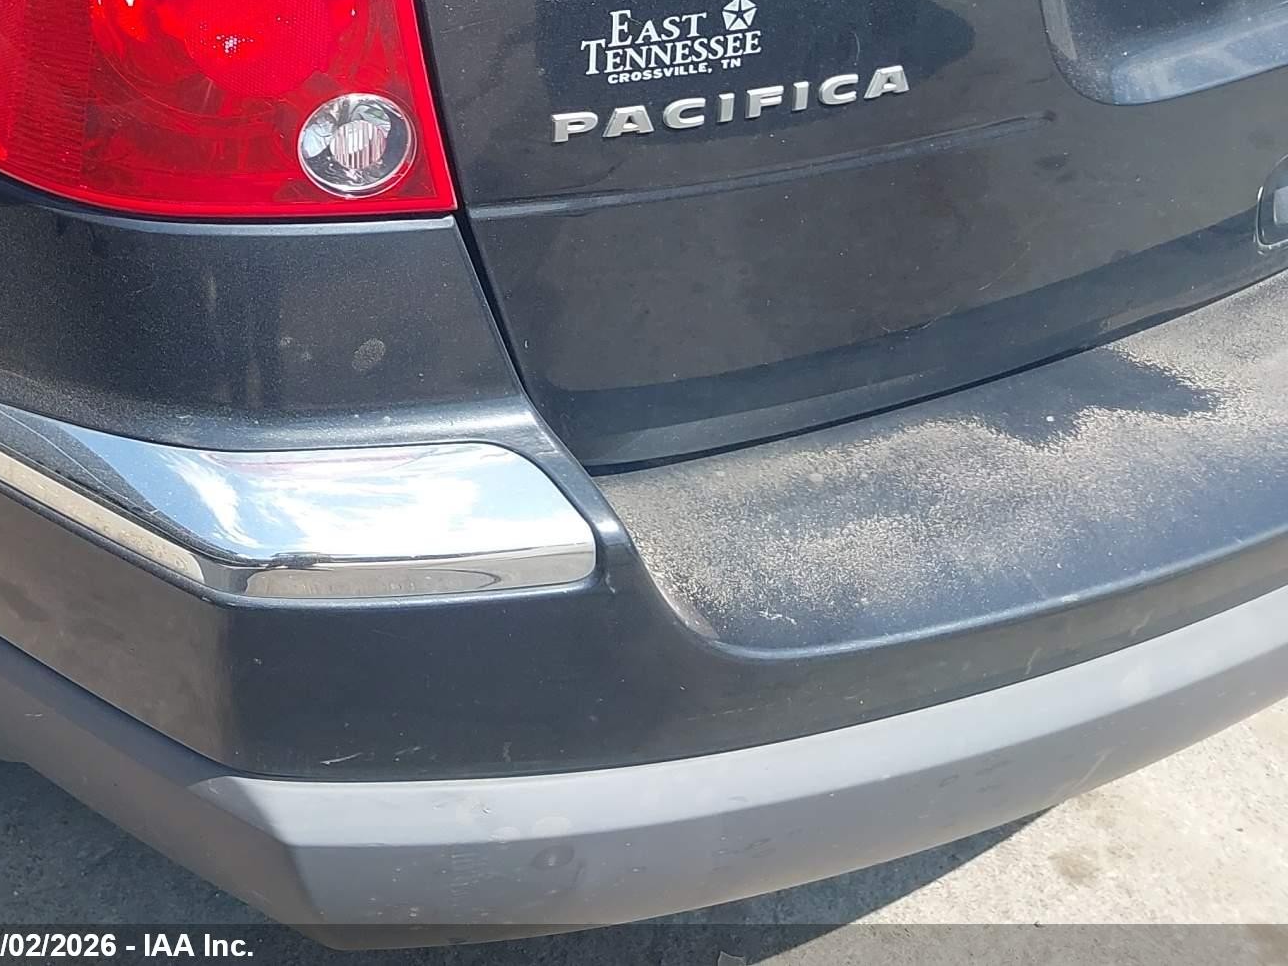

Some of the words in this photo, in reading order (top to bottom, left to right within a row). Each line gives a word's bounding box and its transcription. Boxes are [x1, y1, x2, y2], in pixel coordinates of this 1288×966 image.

[608, 9, 707, 47] EAST
[580, 30, 762, 75] TENNESSEE
[607, 63, 713, 84] CROSSVILLE,
[720, 57, 742, 69] TN
[551, 64, 910, 143] PACIFICA
